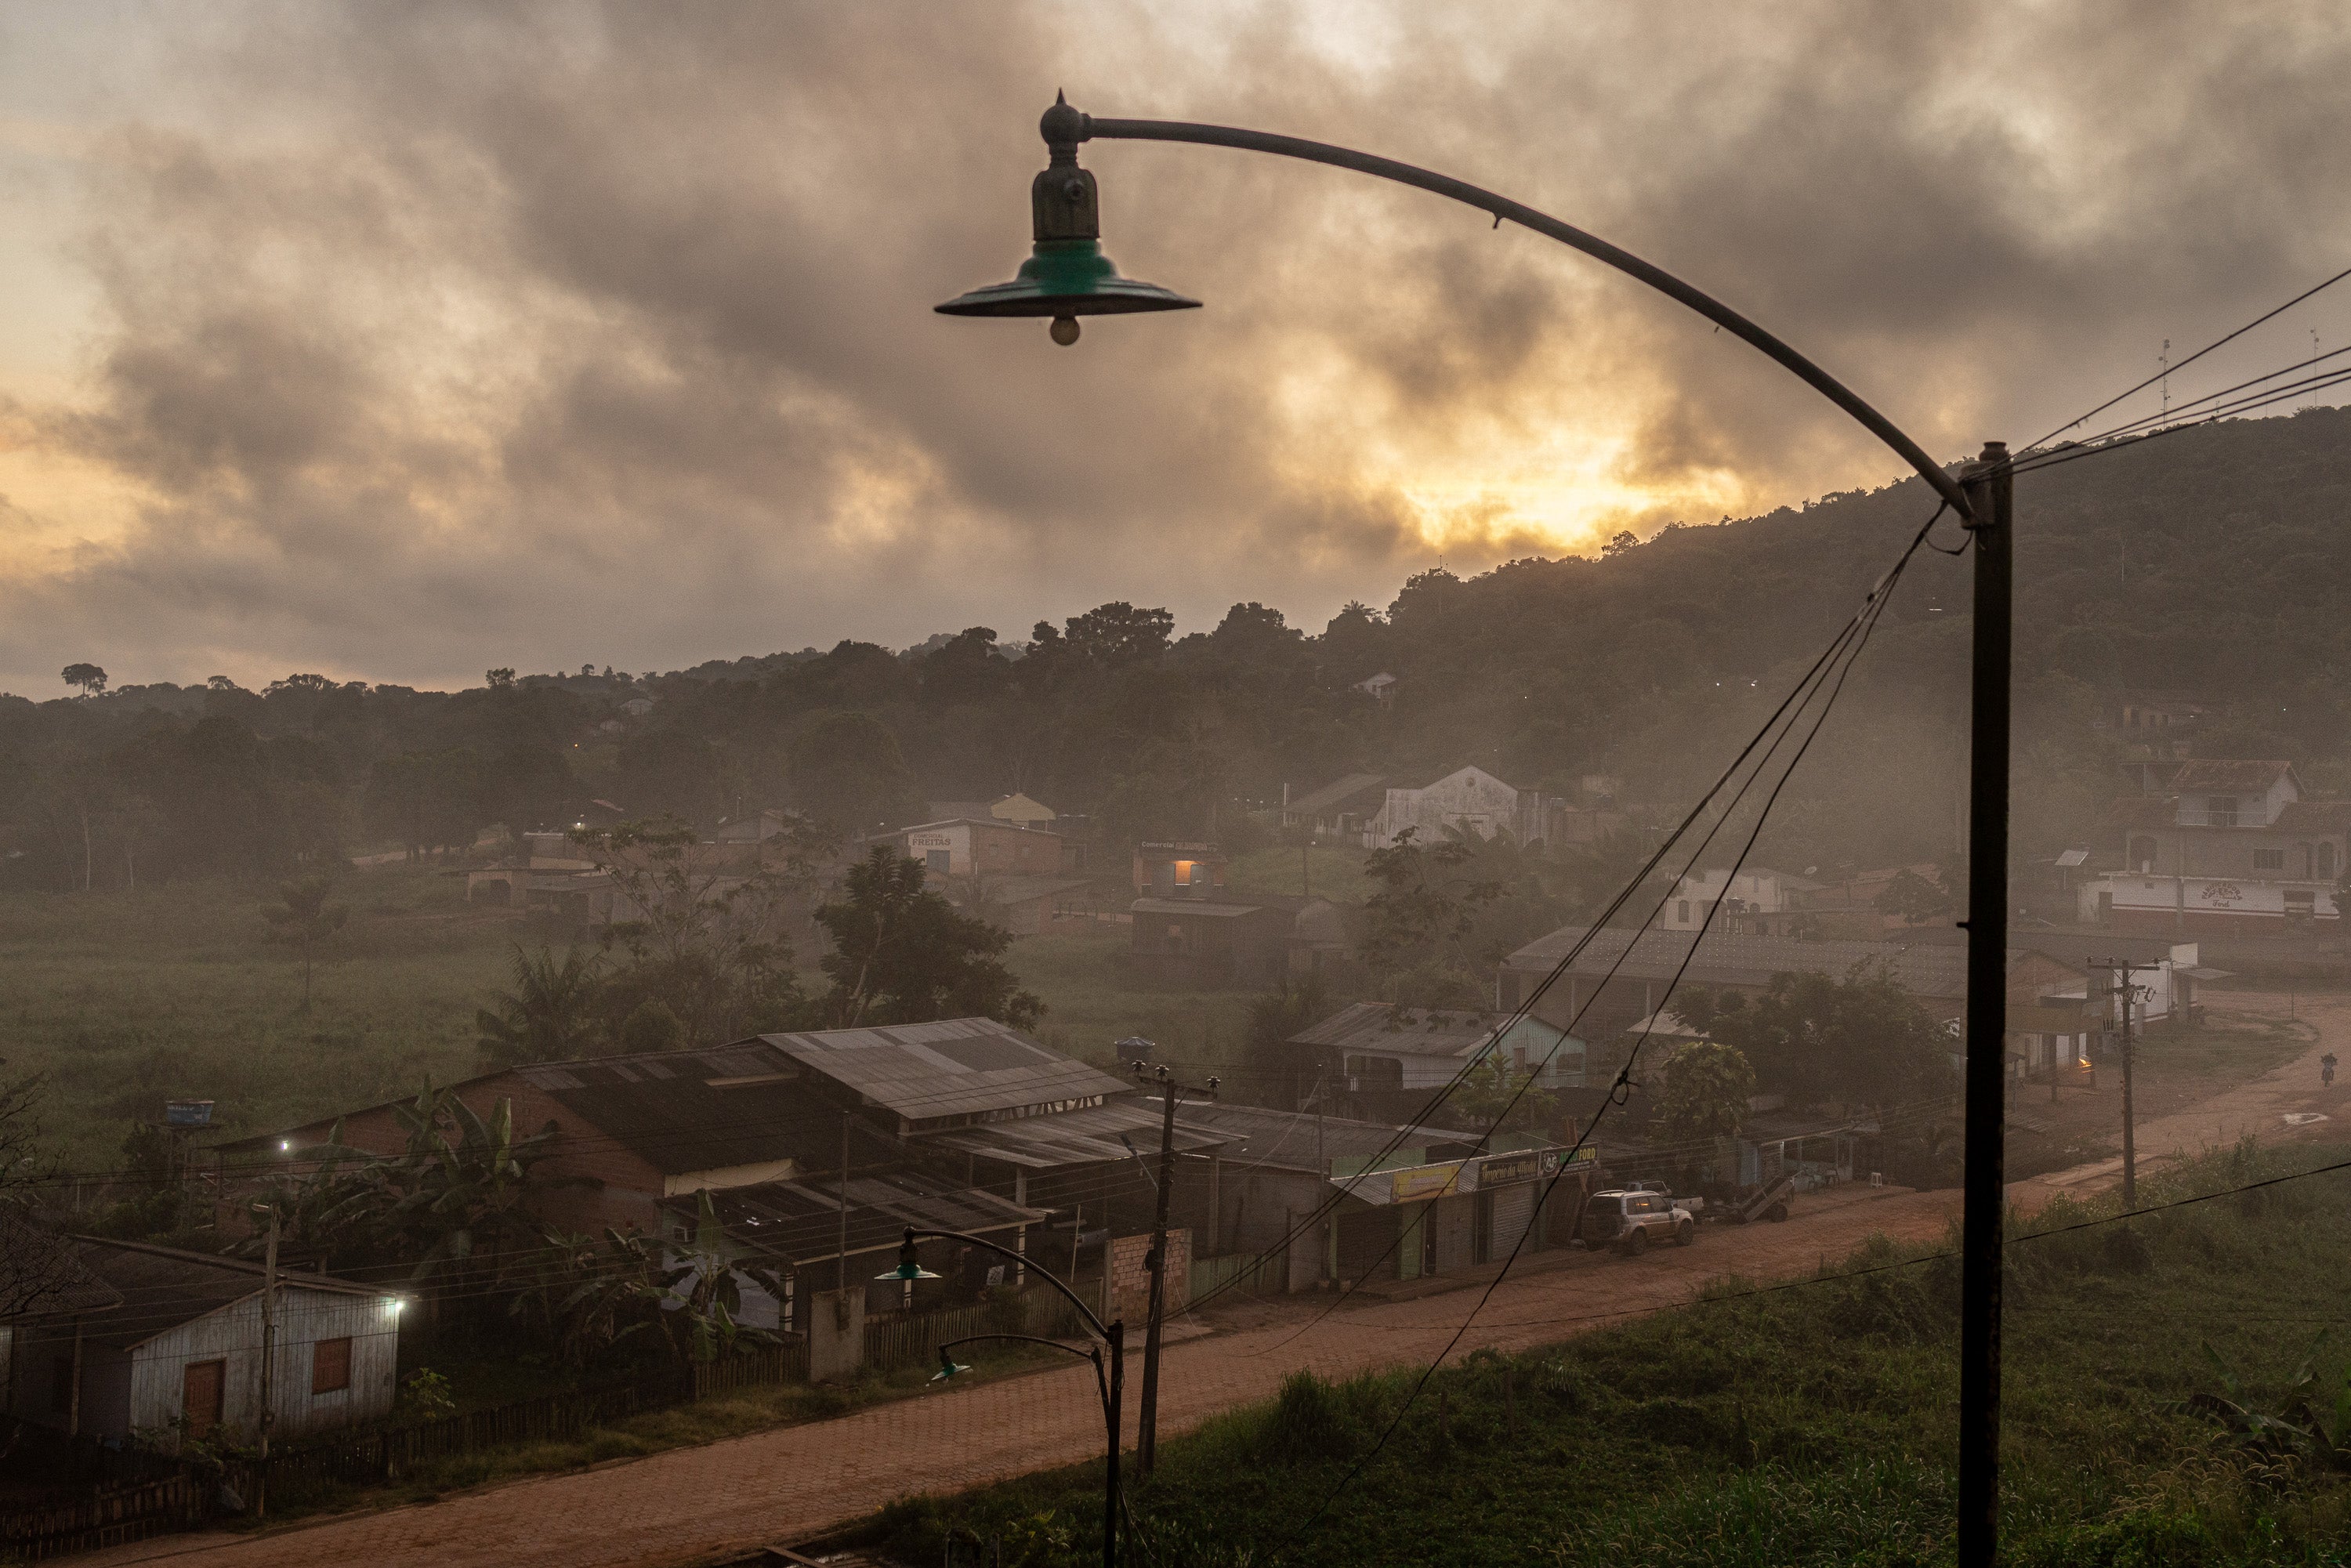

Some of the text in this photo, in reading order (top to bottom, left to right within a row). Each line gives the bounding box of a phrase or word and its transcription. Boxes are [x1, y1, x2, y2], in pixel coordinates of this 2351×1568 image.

[1142, 840, 1175, 849] Comercial
[1578, 1147, 1596, 1161] FORD
[1507, 1164, 1516, 1177] da
